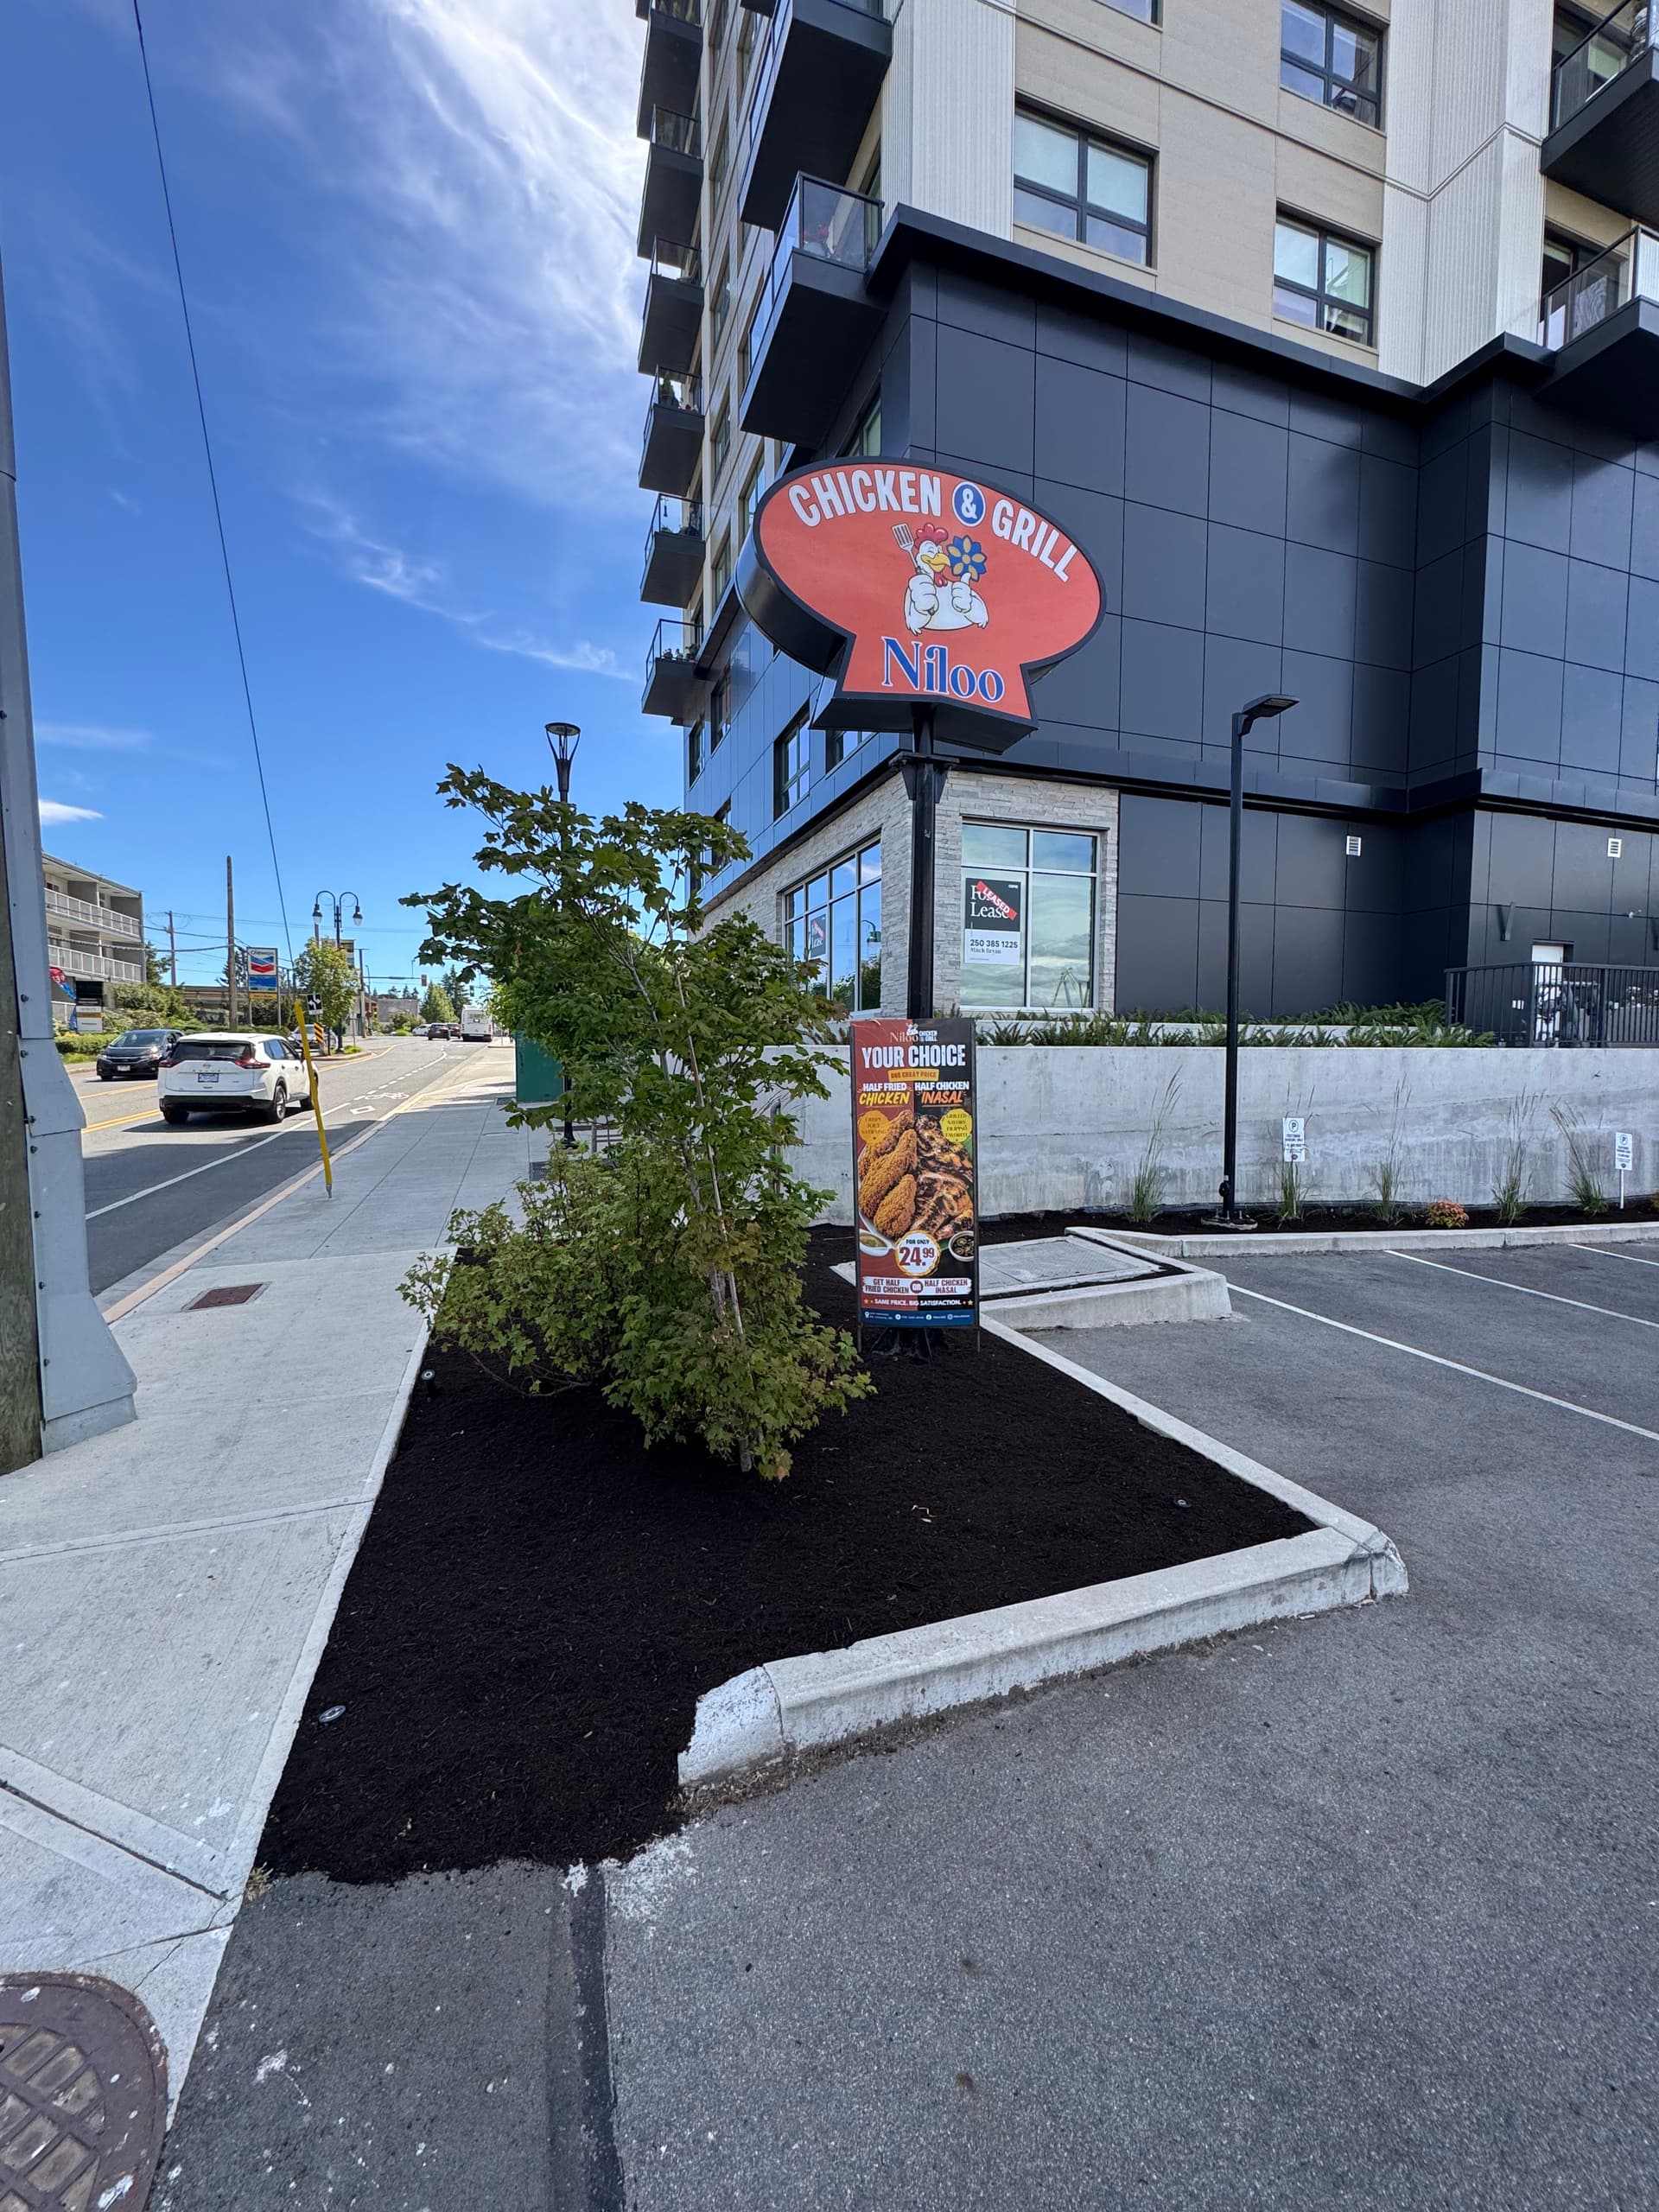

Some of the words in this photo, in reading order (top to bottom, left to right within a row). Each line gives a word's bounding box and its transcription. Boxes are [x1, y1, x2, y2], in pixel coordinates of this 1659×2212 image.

[788, 469, 941, 527] CHICKEN
[961, 487, 978, 519] &
[992, 499, 1077, 582] GRILL
[881, 636, 1004, 702] Niloo
[982, 887, 1010, 913] LEASED
[969, 938, 985, 947] 250
[986, 939, 1001, 948] 385
[1001, 940, 1019, 949] 1225
[890, 1032, 918, 1042] Niloo
[861, 1046, 905, 1069] YOUR
[908, 1045, 966, 1067] CHOICE
[862, 1083, 883, 1092] HALF
[883, 1082, 907, 1091] FRIED
[914, 1082, 935, 1091] HALF
[936, 1081, 969, 1090] CHICKEN
[859, 1091, 910, 1106] CHICKEN
[921, 1090, 963, 1104] INASAL
[941, 1278, 969, 1287] CHICKEN
